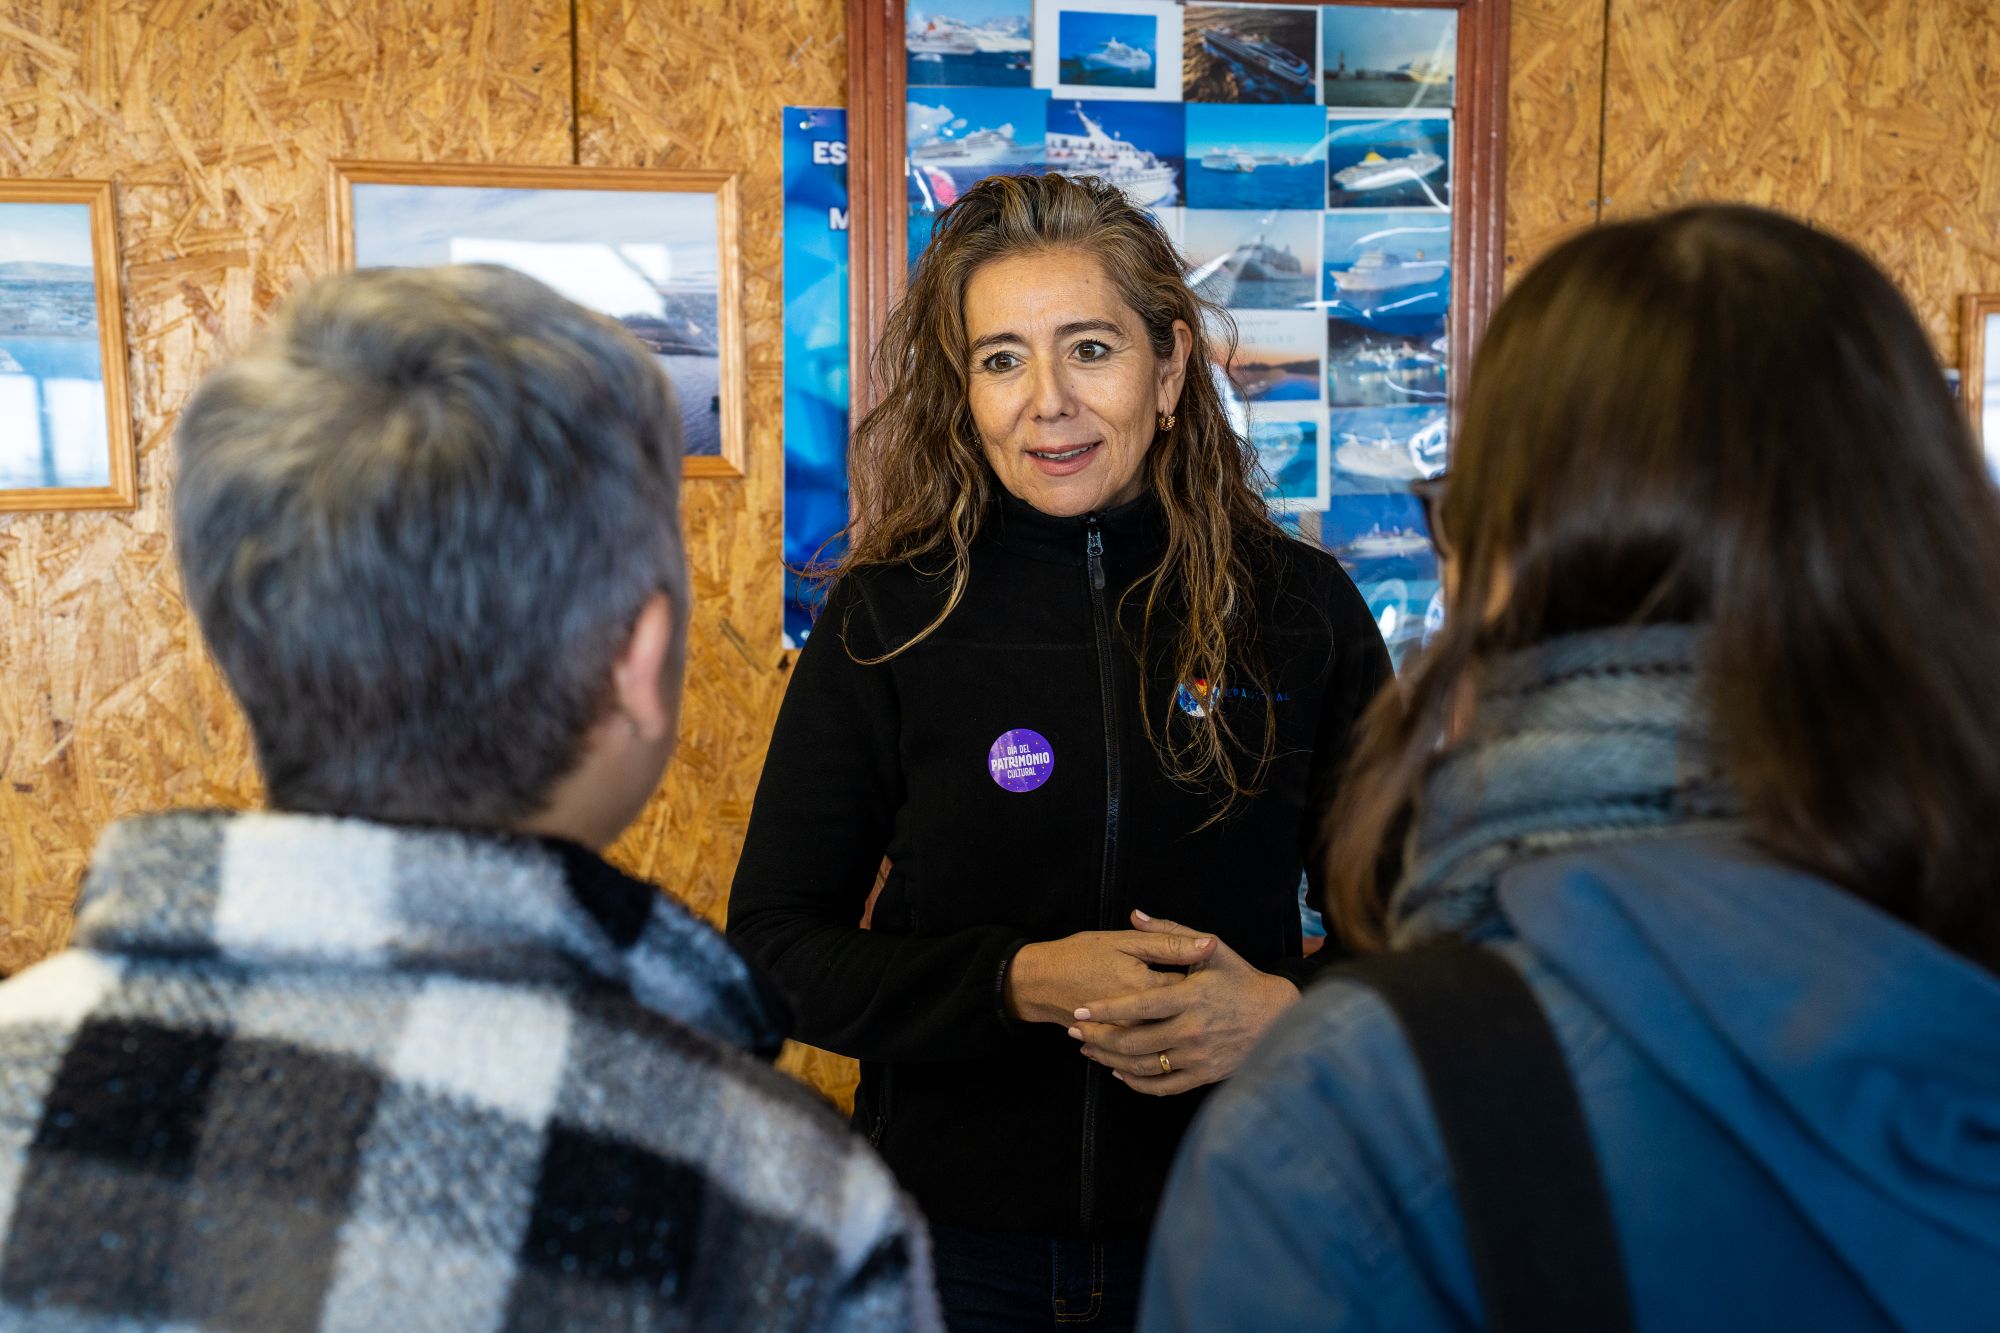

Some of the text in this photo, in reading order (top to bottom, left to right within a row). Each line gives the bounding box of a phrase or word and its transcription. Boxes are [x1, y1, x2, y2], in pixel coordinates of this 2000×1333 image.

[813, 141, 847, 165] ES
[1019, 744, 1031, 754] DEL
[991, 752, 1050, 771] PATRIMONIO
[1007, 767, 1036, 779] CULTURAL
